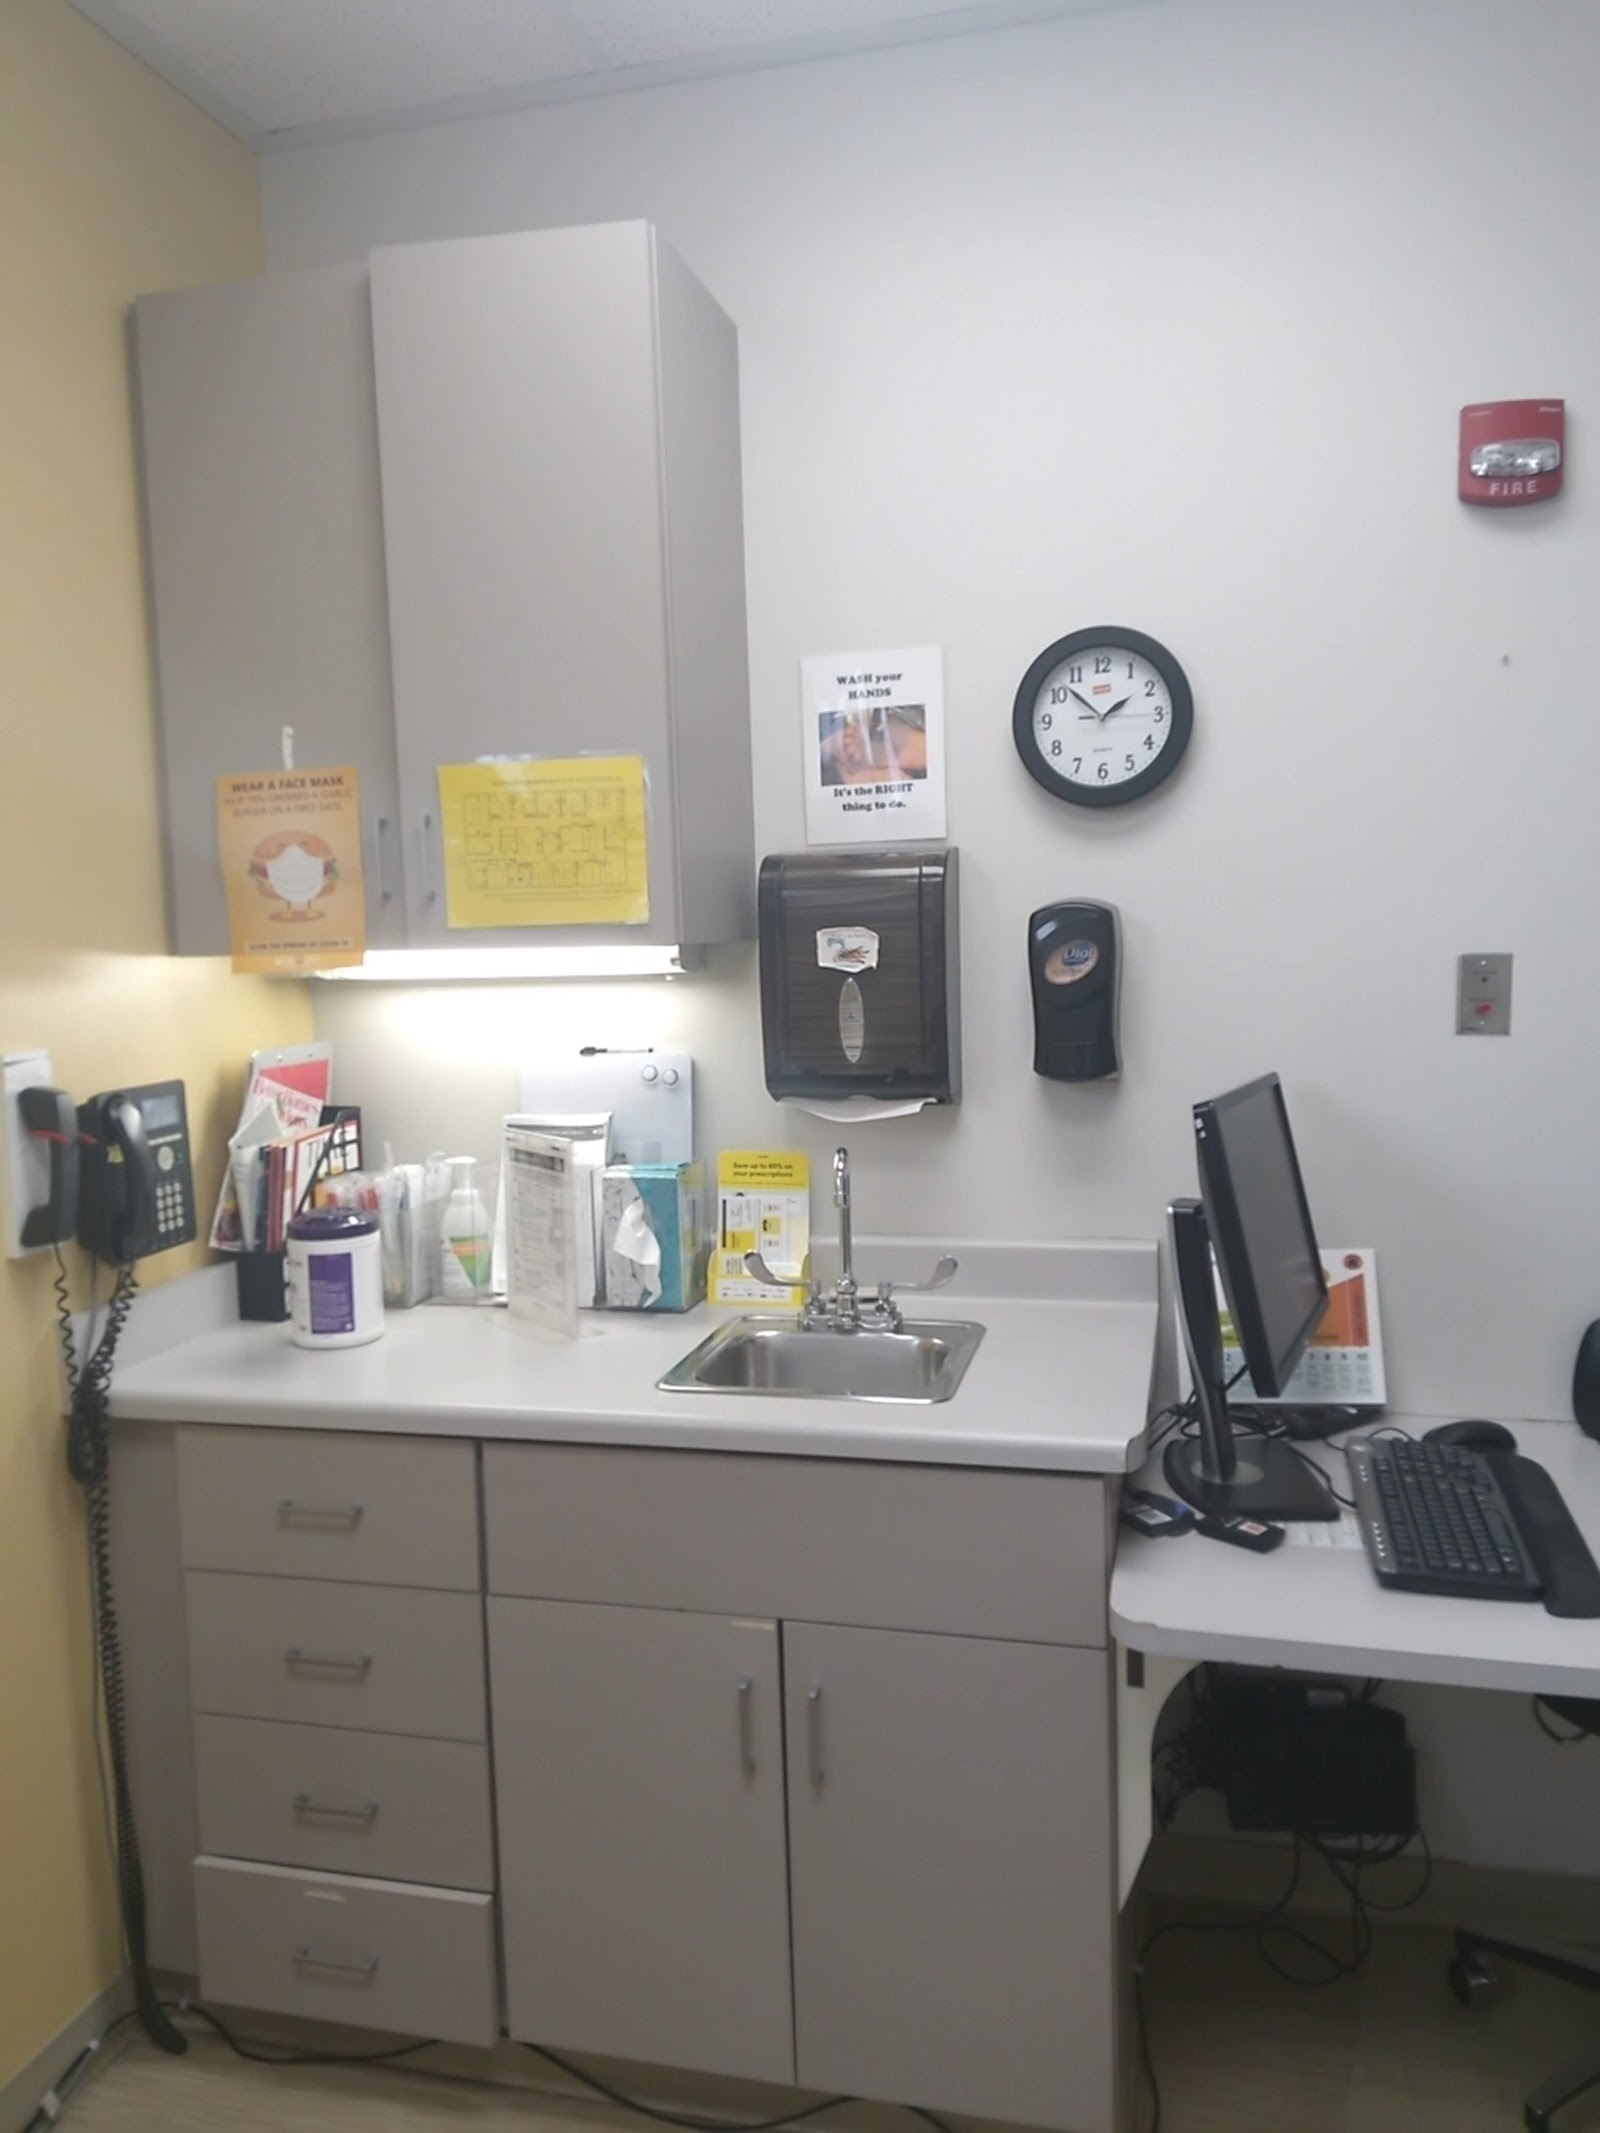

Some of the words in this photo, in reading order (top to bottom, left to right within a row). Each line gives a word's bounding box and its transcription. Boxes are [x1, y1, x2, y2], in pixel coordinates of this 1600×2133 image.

[1489, 479, 1537, 495] FIRE
[1094, 656, 1112, 674] 12
[1127, 662, 1134, 679] 1
[836, 674, 873, 685] WASH
[875, 673, 902, 684] your
[1069, 666, 1083, 683] 11
[848, 687, 892, 700] HANDS
[1051, 686, 1068, 705] 10
[1144, 680, 1155, 697] 2
[1041, 713, 1053, 731] 9
[1153, 705, 1164, 723] 3
[1051, 739, 1063, 756] 8
[1143, 734, 1155, 750] 4
[1073, 757, 1083, 774] 7
[1097, 762, 1109, 779] 6
[1125, 754, 1135, 771] 5
[231, 781, 264, 793] WEAR
[267, 780, 277, 790] A
[279, 778, 307, 790] FACE
[310, 775, 345, 787] MASK
[833, 787, 852, 798] It's
[854, 787, 873, 796] the
[874, 783, 914, 794] RIGHT
[842, 802, 873, 812] thing
[874, 801, 886, 809] to
[1063, 946, 1093, 960] Dial
